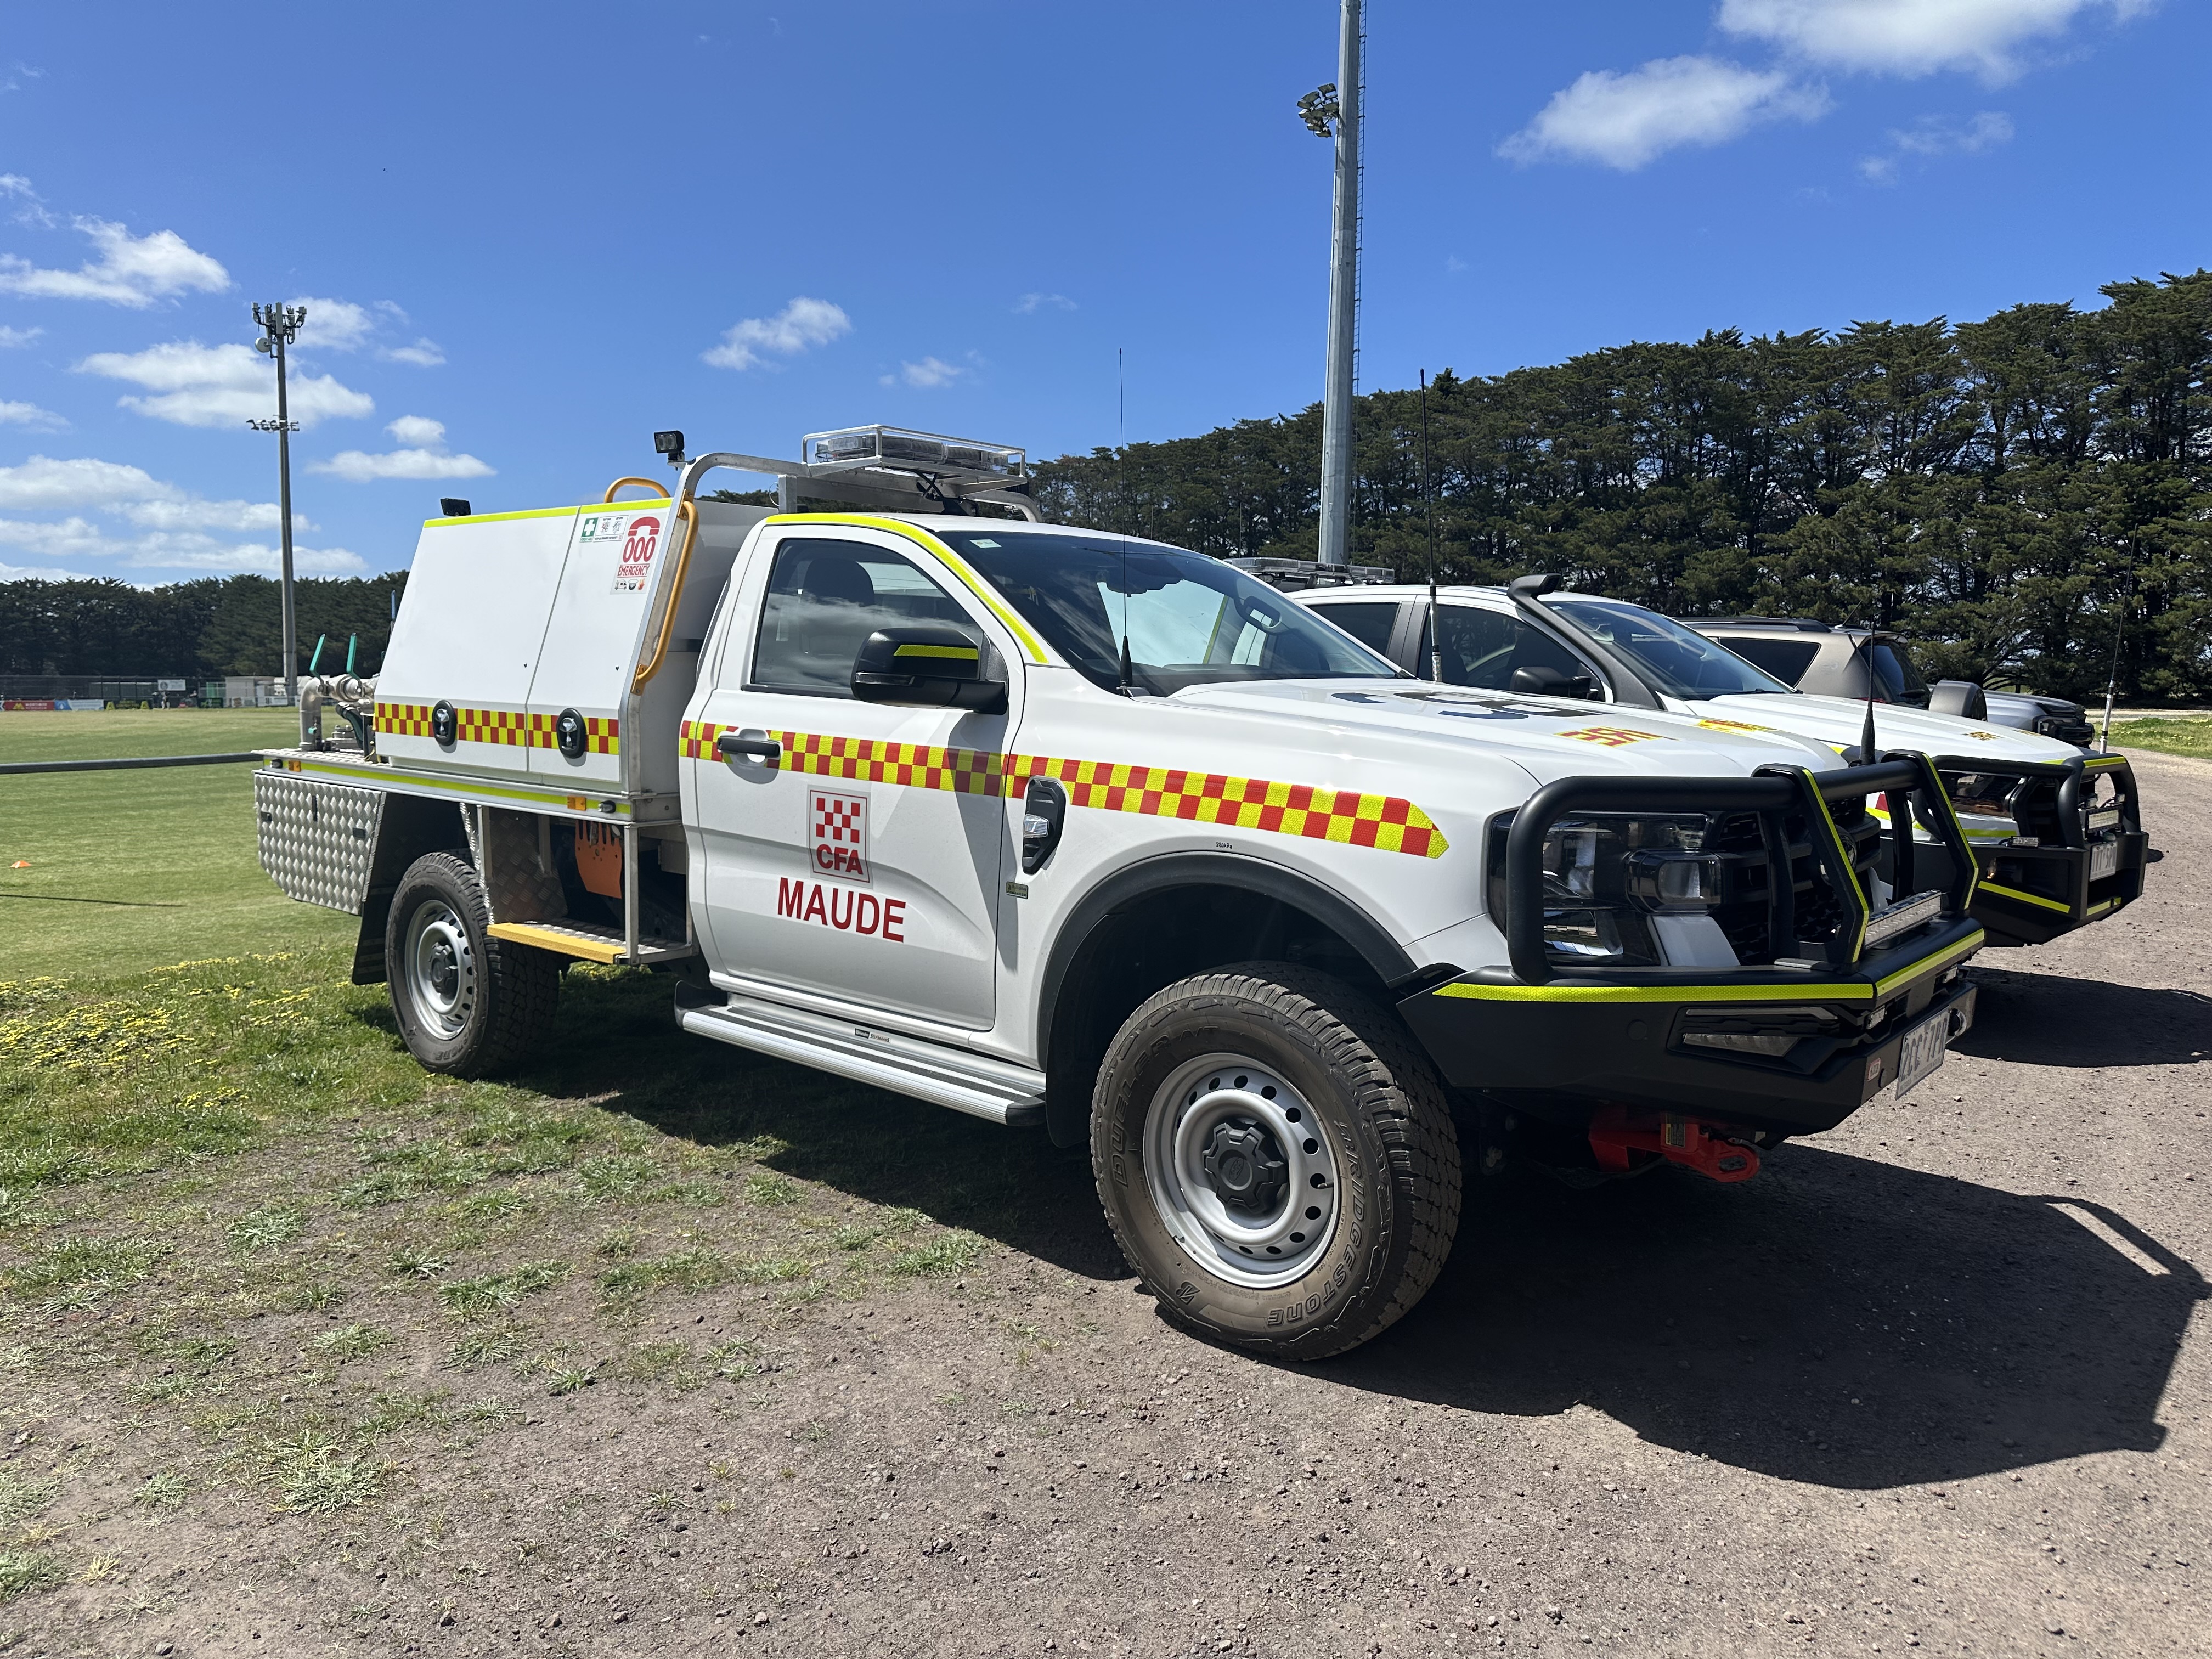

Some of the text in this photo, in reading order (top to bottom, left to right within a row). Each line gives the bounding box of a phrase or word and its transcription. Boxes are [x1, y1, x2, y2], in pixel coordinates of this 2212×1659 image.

[623, 536, 656, 563] 000
[617, 565, 650, 577] EMERGENCY
[816, 844, 864, 875] CFA
[777, 877, 906, 943] MAUDE
[1267, 1119, 1365, 1327] BRIDGESTONE
